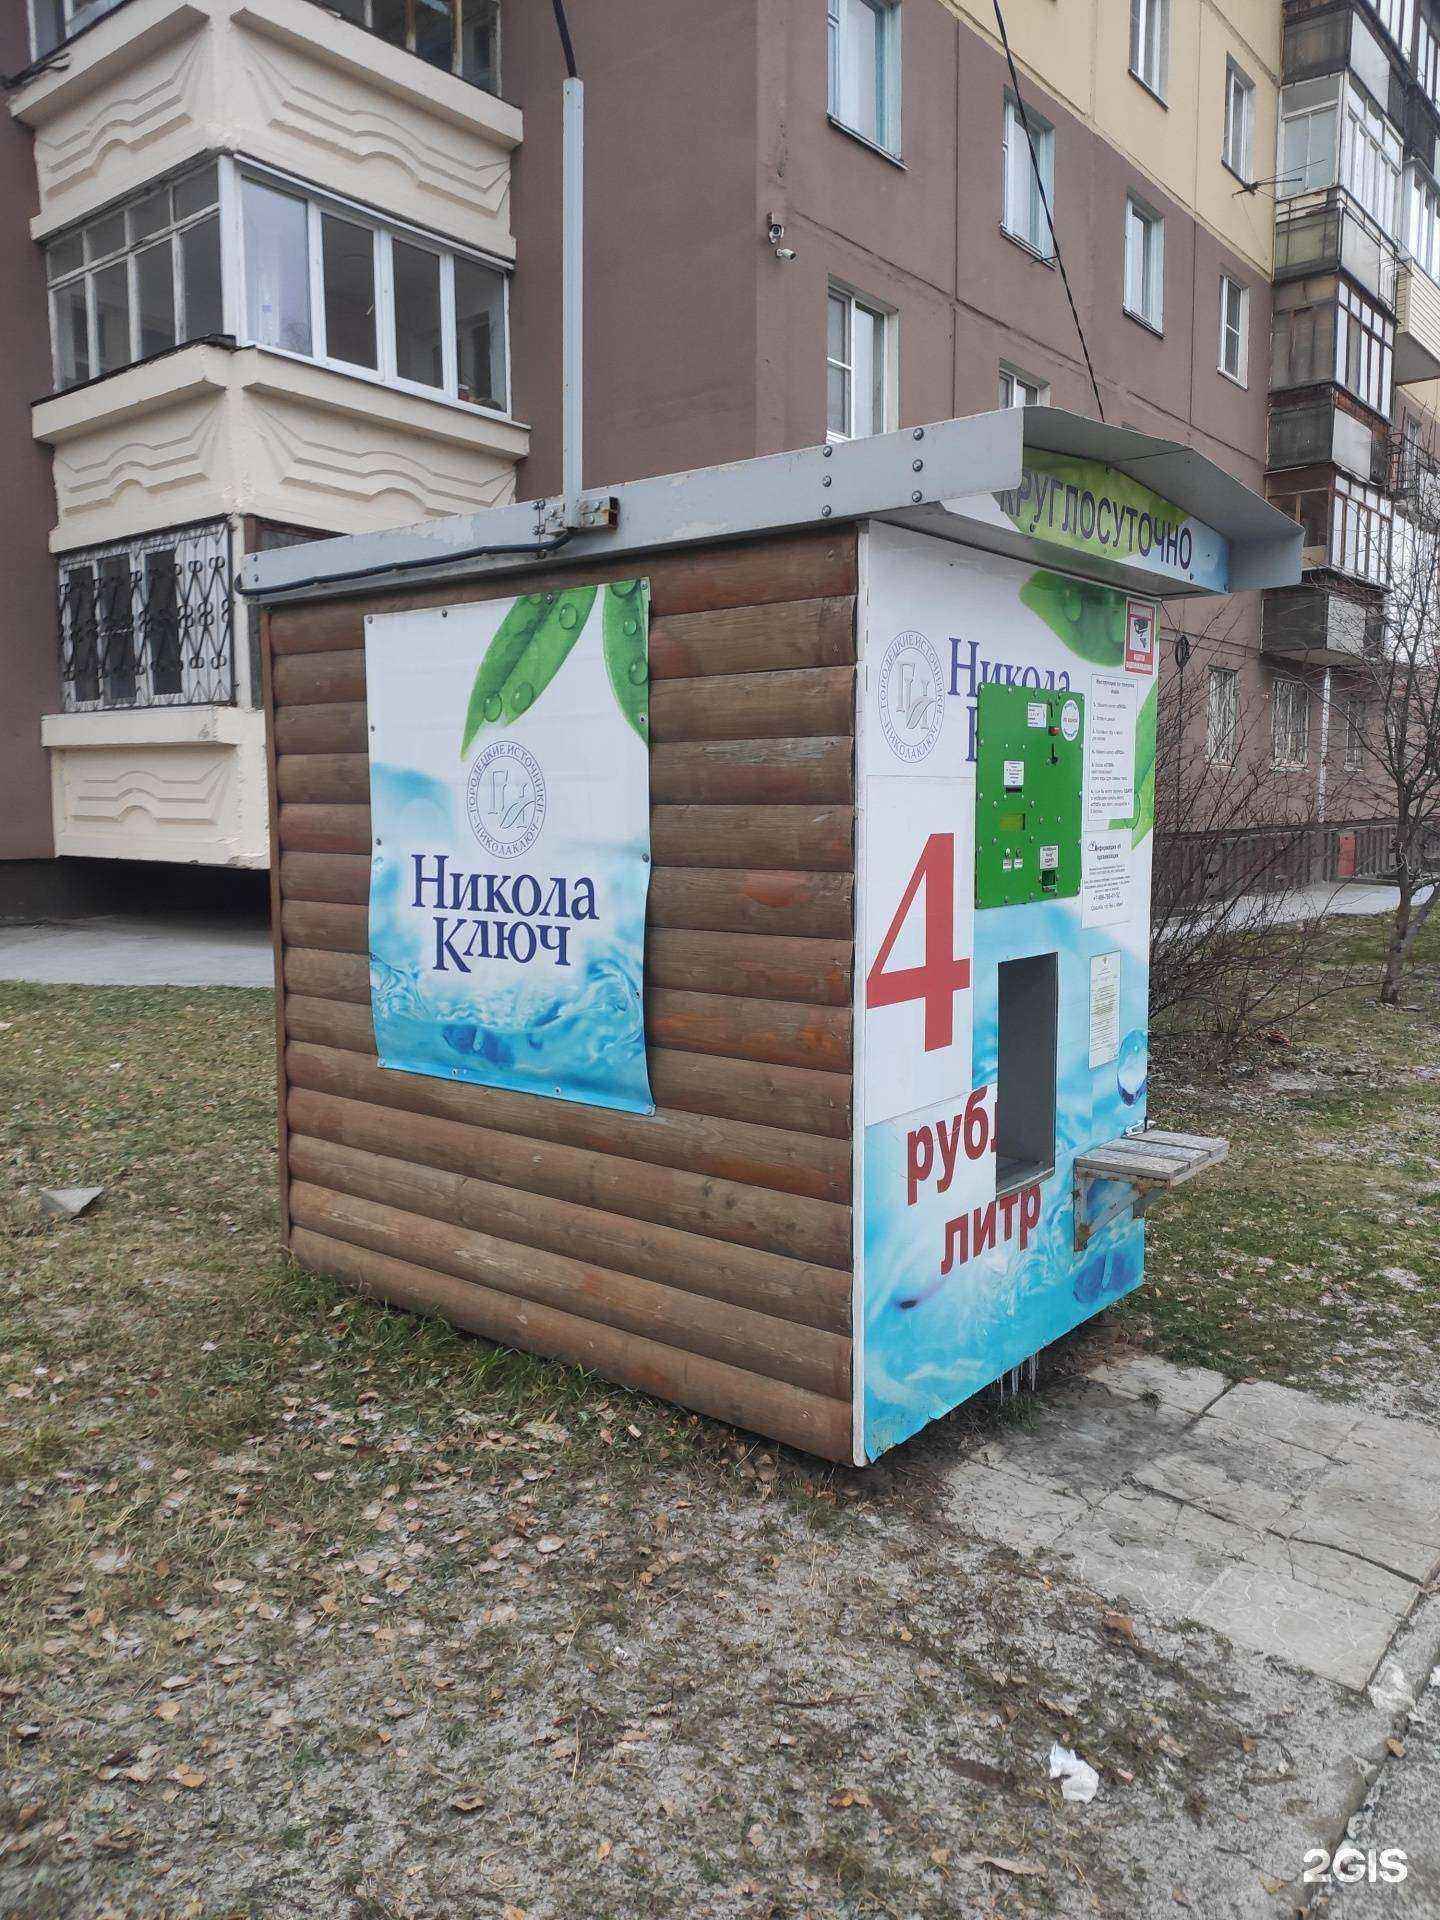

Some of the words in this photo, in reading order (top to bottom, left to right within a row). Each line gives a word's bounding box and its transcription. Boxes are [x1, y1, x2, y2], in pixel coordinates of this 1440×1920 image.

[411, 854, 600, 920] Никола
[433, 916, 571, 973] Ключ
[866, 833, 970, 1052] 4
[941, 1183, 1041, 1276] литр
